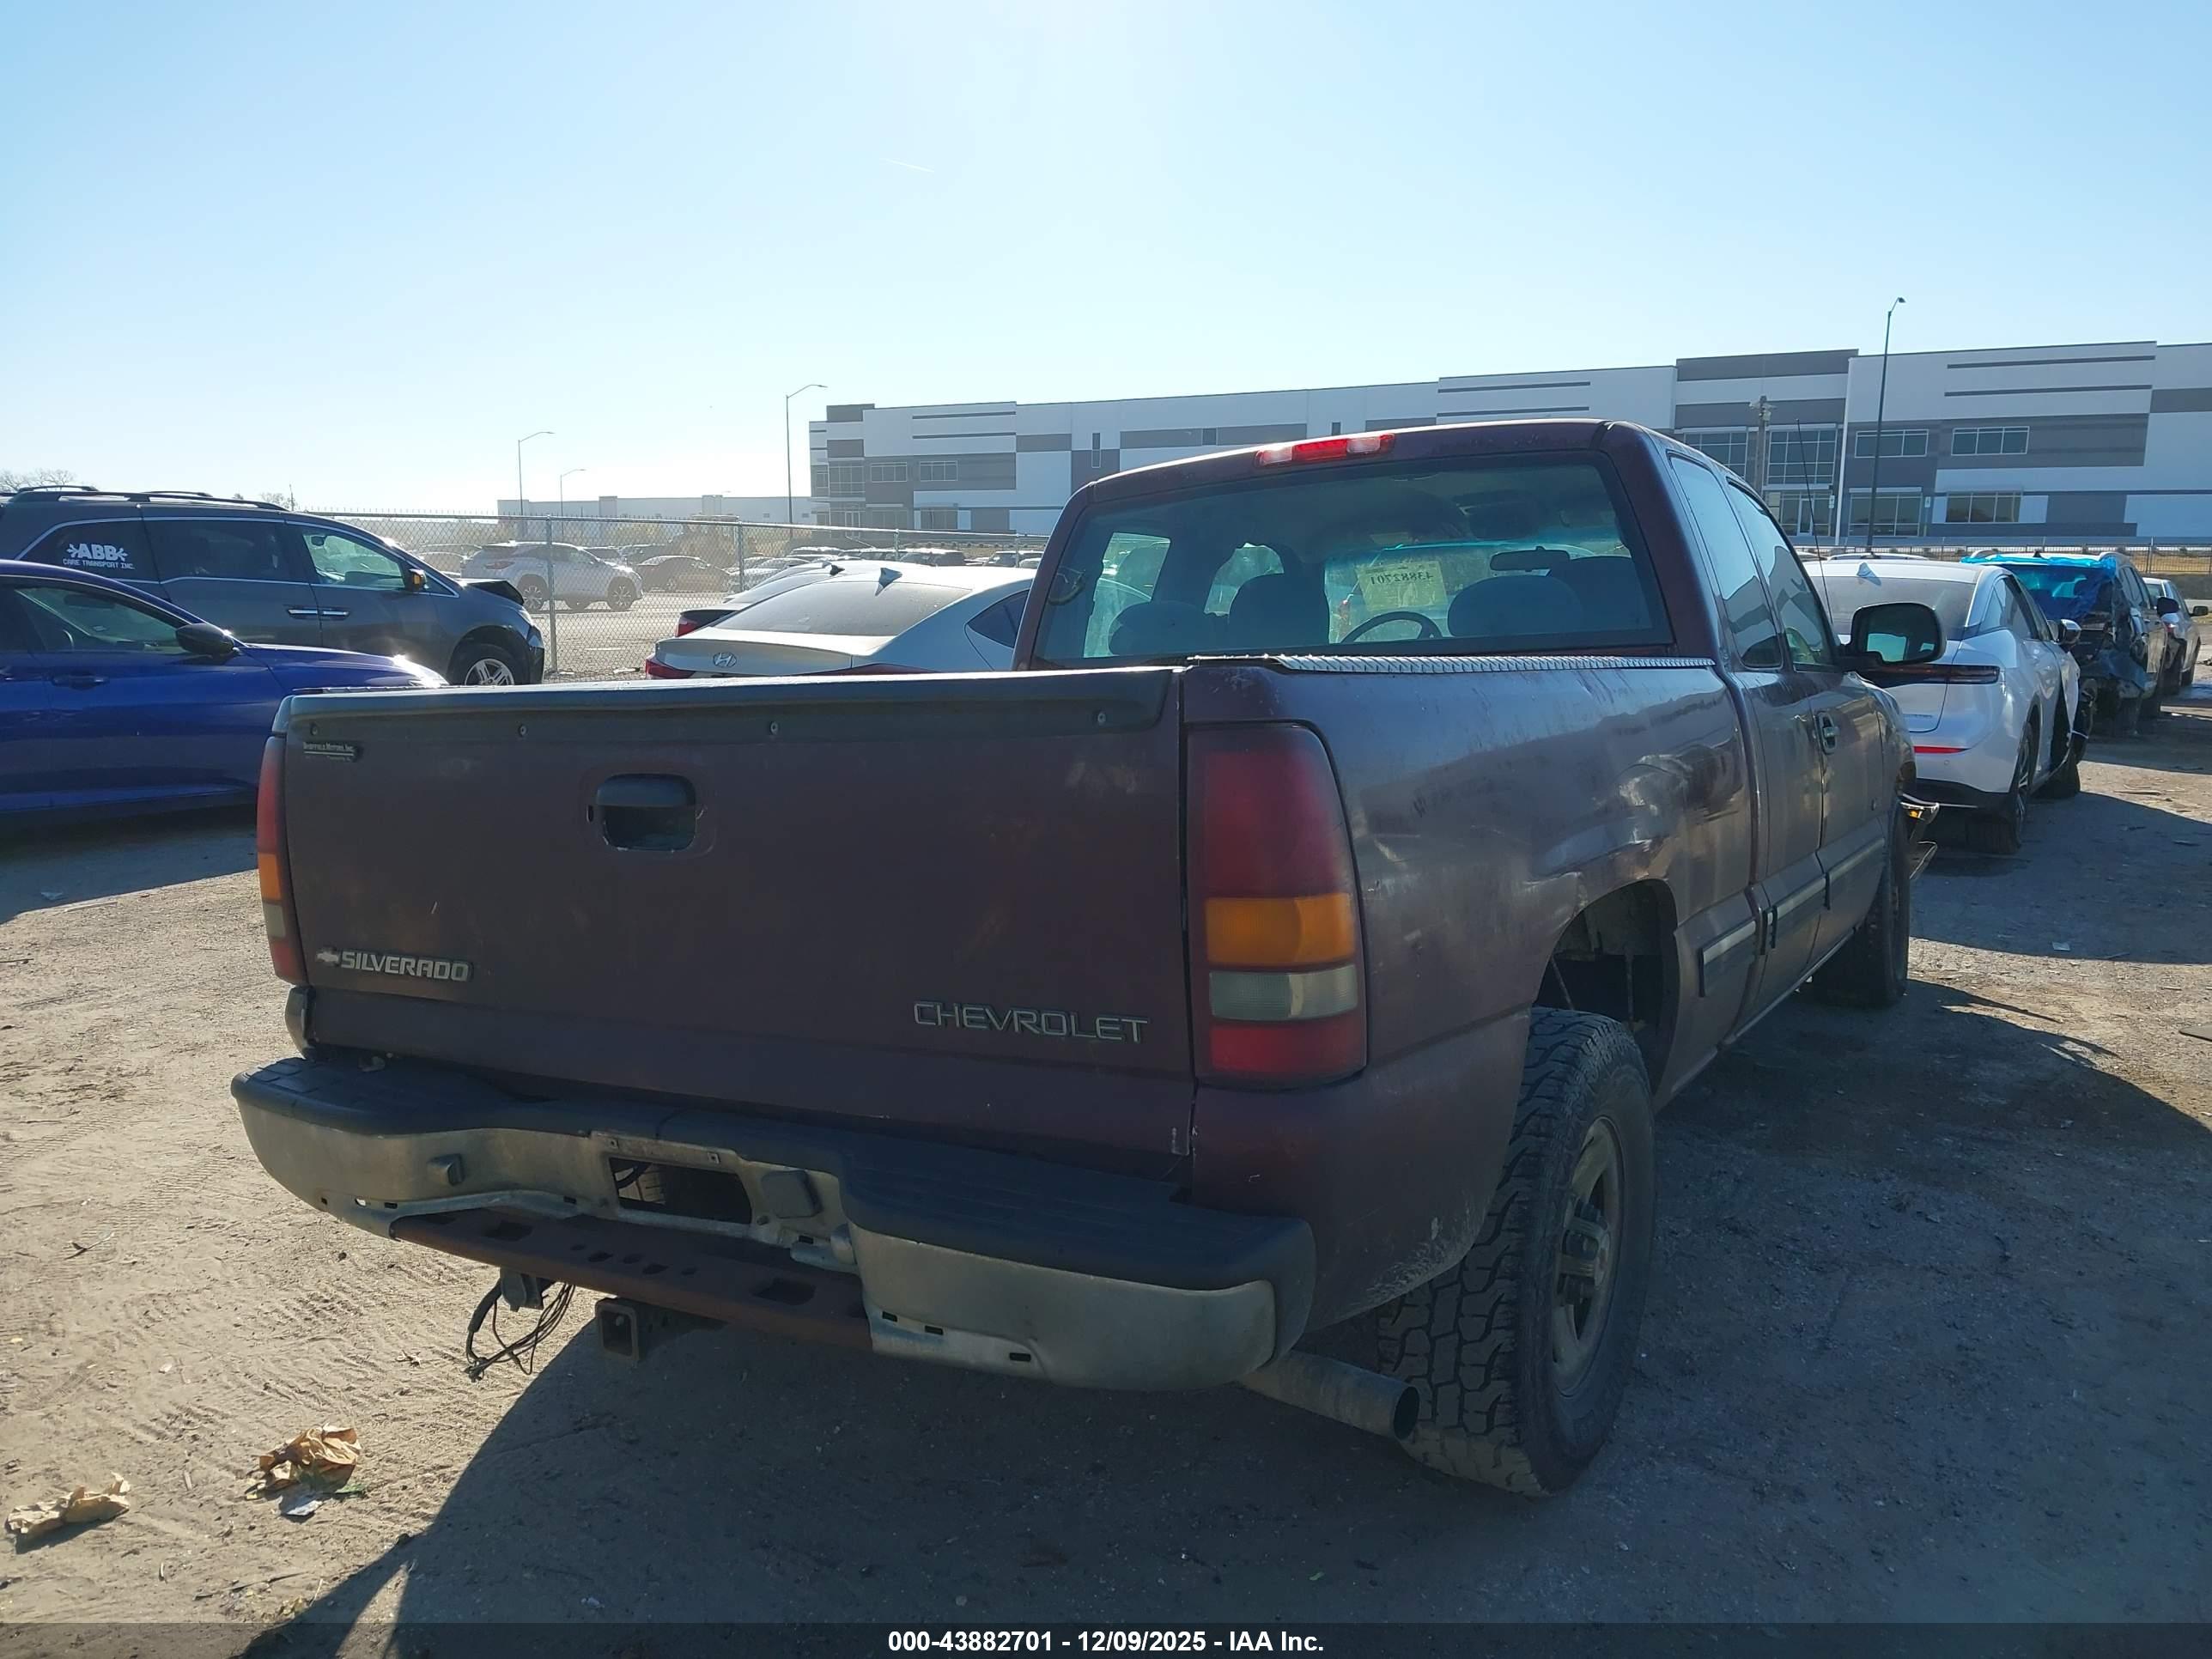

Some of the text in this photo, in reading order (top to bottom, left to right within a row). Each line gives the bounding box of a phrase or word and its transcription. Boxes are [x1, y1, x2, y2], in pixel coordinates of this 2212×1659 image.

[77, 543, 118, 561] ABB
[82, 560, 118, 568] TRANSPORT
[341, 951, 469, 981] SILVERADO
[914, 1001, 1149, 1042] CHEVROLET
